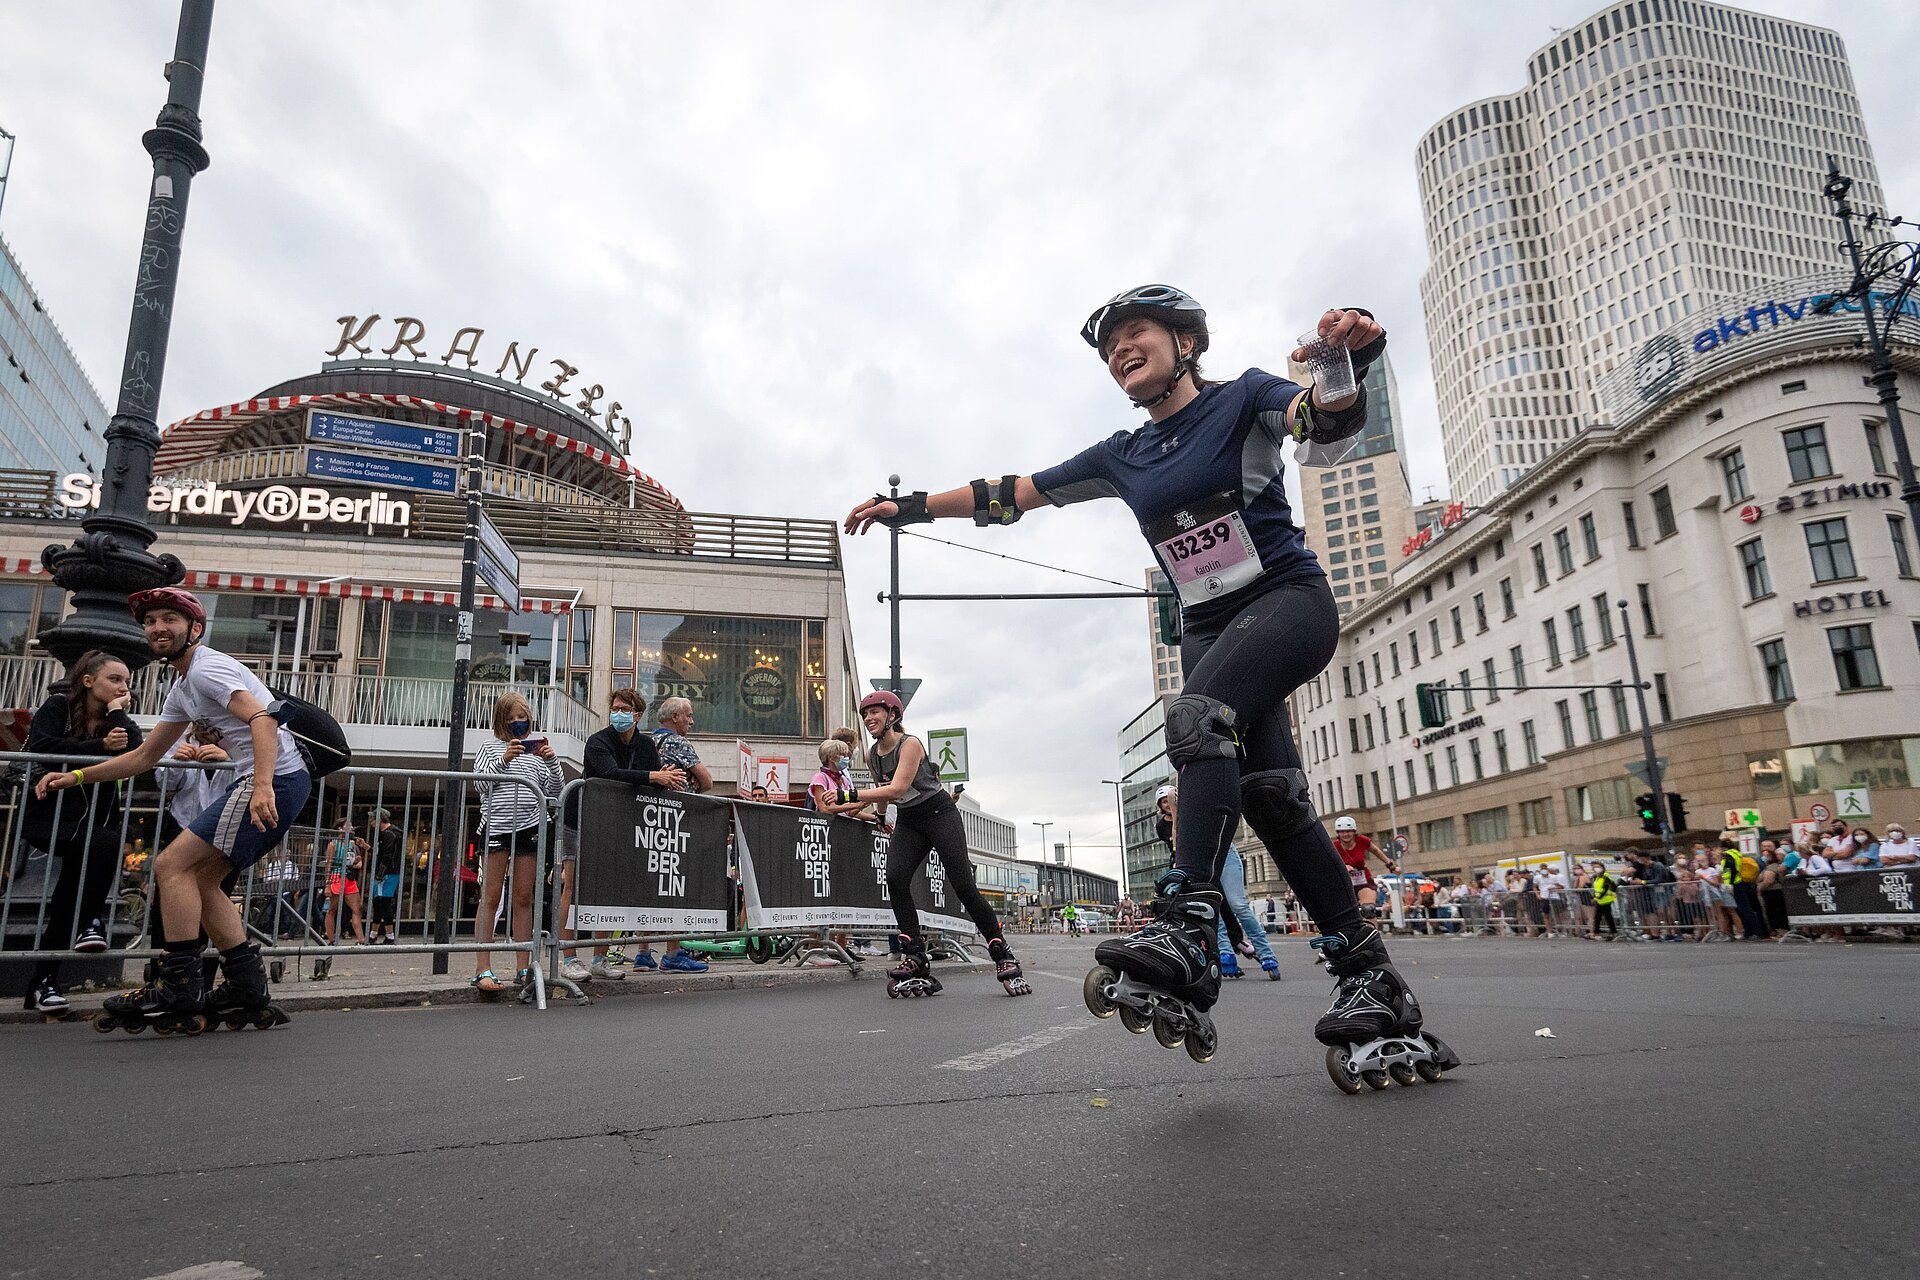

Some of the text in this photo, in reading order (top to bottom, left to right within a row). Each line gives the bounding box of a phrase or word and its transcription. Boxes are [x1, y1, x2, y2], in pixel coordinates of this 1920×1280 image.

[332, 425, 374, 436] Europa-Center
[333, 417, 345, 425] Zoo
[348, 419, 376, 429] Aquarium
[332, 432, 422, 450] Kaiser-Wilhelm-Gedächtniskirche
[329, 464, 362, 475] Jüdisches
[364, 469, 414, 482] Gemeindehaus
[330, 457, 355, 467] Maison
[366, 462, 390, 471] France
[432, 471, 443, 479] 500
[1166, 522, 1230, 562] 13239
[1193, 560, 1221, 576] Karolin
[1793, 589, 1892, 617] HOTEL
[745, 672, 782, 687] SUPERDRY
[752, 695, 775, 706] BRAND
[636, 795, 683, 808] ADIDAS RUNNERS
[643, 804, 686, 830] CITY
[635, 825, 691, 853] NIGHT
[801, 824, 830, 843] CITY
[647, 850, 680, 875] BER
[804, 861, 830, 880] BER
[657, 874, 686, 897] LIN
[1882, 875, 1908, 885] CITY
[1879, 883, 1913, 894] NIGHT
[1887, 892, 1909, 902] BER
[1895, 900, 1913, 910] LIN
[652, 916, 674, 924] EVENTS
[697, 917, 719, 925] EVENTS
